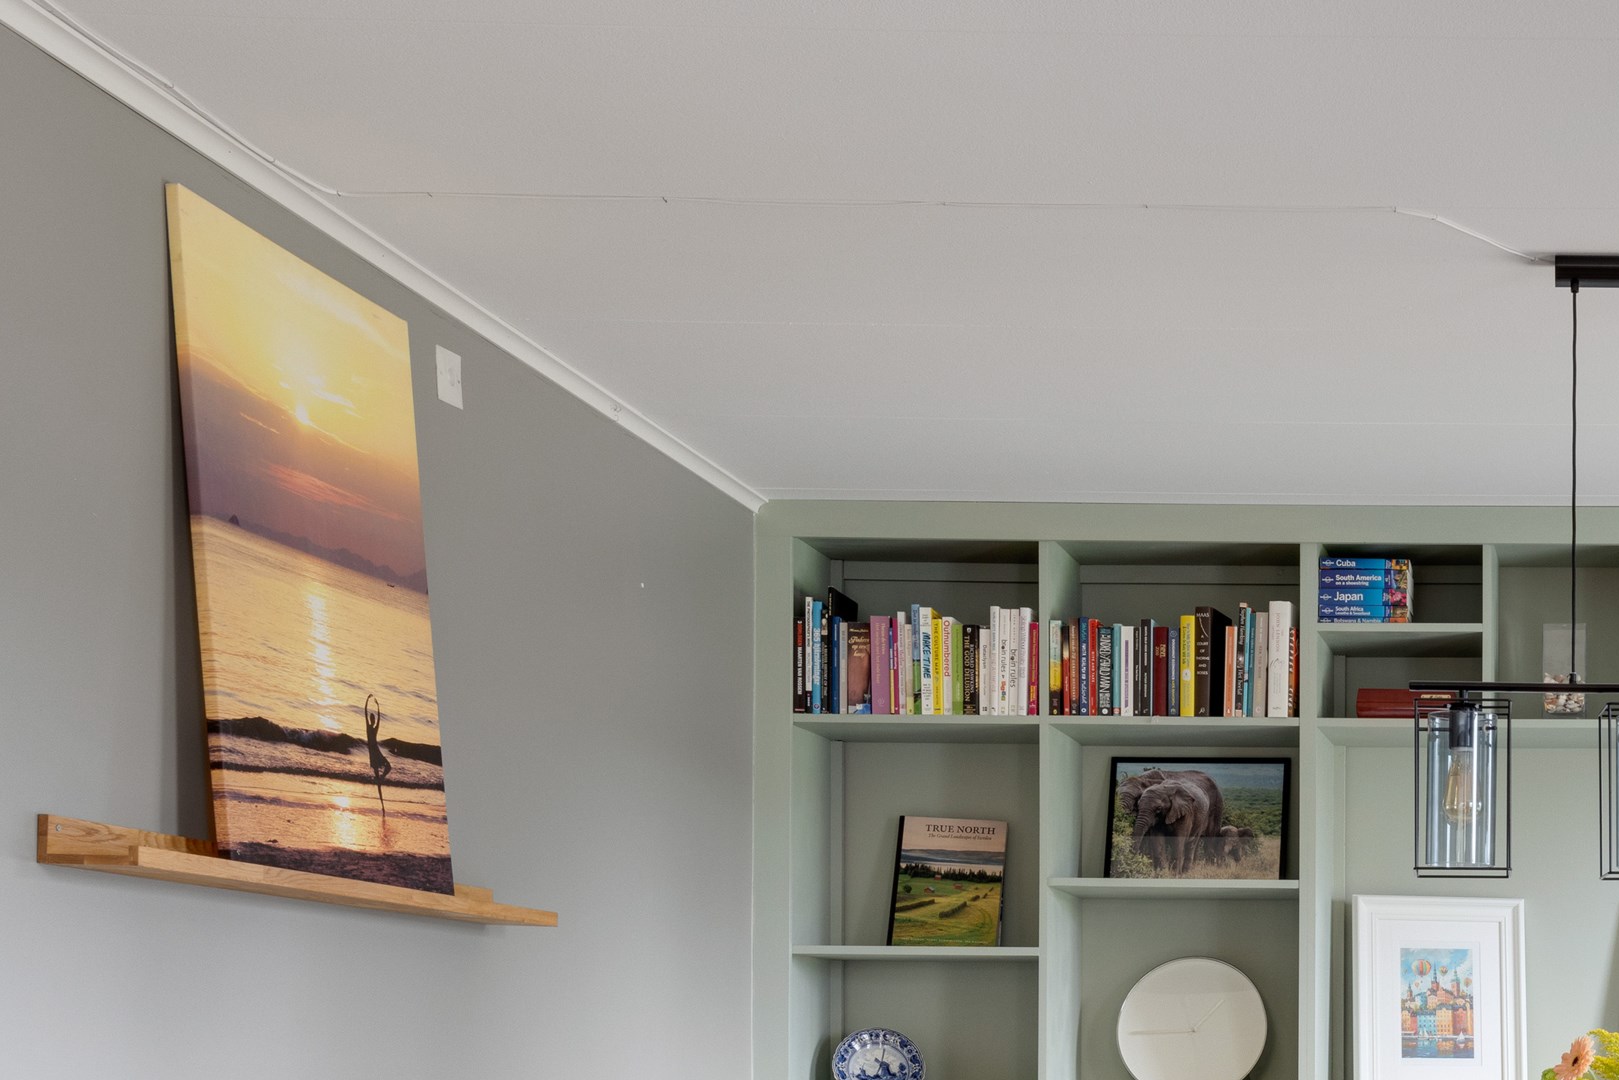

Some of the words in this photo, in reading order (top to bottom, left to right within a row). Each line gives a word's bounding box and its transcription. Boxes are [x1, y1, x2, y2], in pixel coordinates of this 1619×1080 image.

[1336, 559, 1356, 567] Cuba
[1334, 592, 1363, 603] Japan
[813, 628, 821, 641] 365
[922, 632, 931, 654] MAKE
[922, 657, 931, 679] TIME
[1010, 669, 1018, 688] rules
[925, 824, 954, 833] TRUE
[957, 825, 996, 835] NORTH
